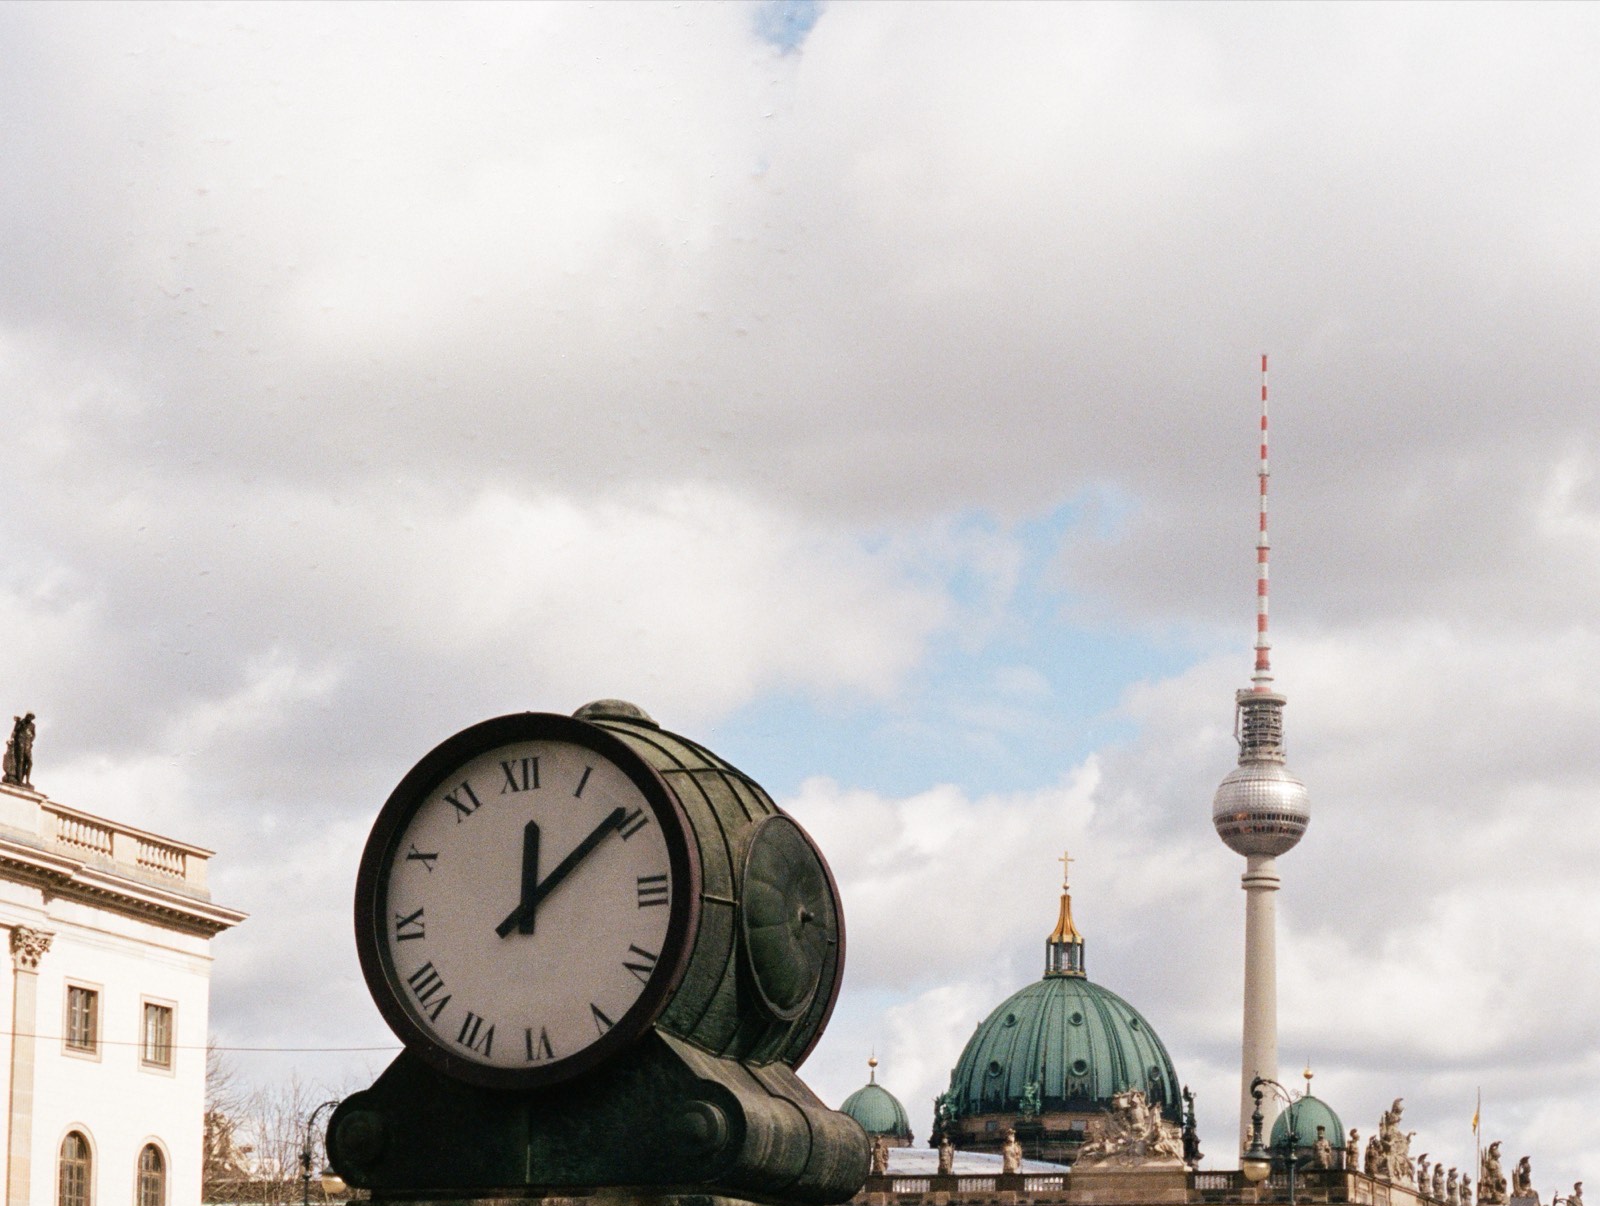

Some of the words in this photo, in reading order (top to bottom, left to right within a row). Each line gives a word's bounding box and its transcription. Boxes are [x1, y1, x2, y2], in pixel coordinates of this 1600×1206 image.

[500, 756, 541, 794] XII
[573, 766, 593, 799] I
[443, 780, 483, 824] XI
[406, 844, 438, 872] X
[637, 874, 669, 908] III
[396, 907, 425, 942] IX
[622, 944, 658, 984] IV
[407, 961, 452, 1023] VIII
[456, 1011, 497, 1058] VII
[589, 1002, 615, 1035] V
[525, 1026, 554, 1062] VI
